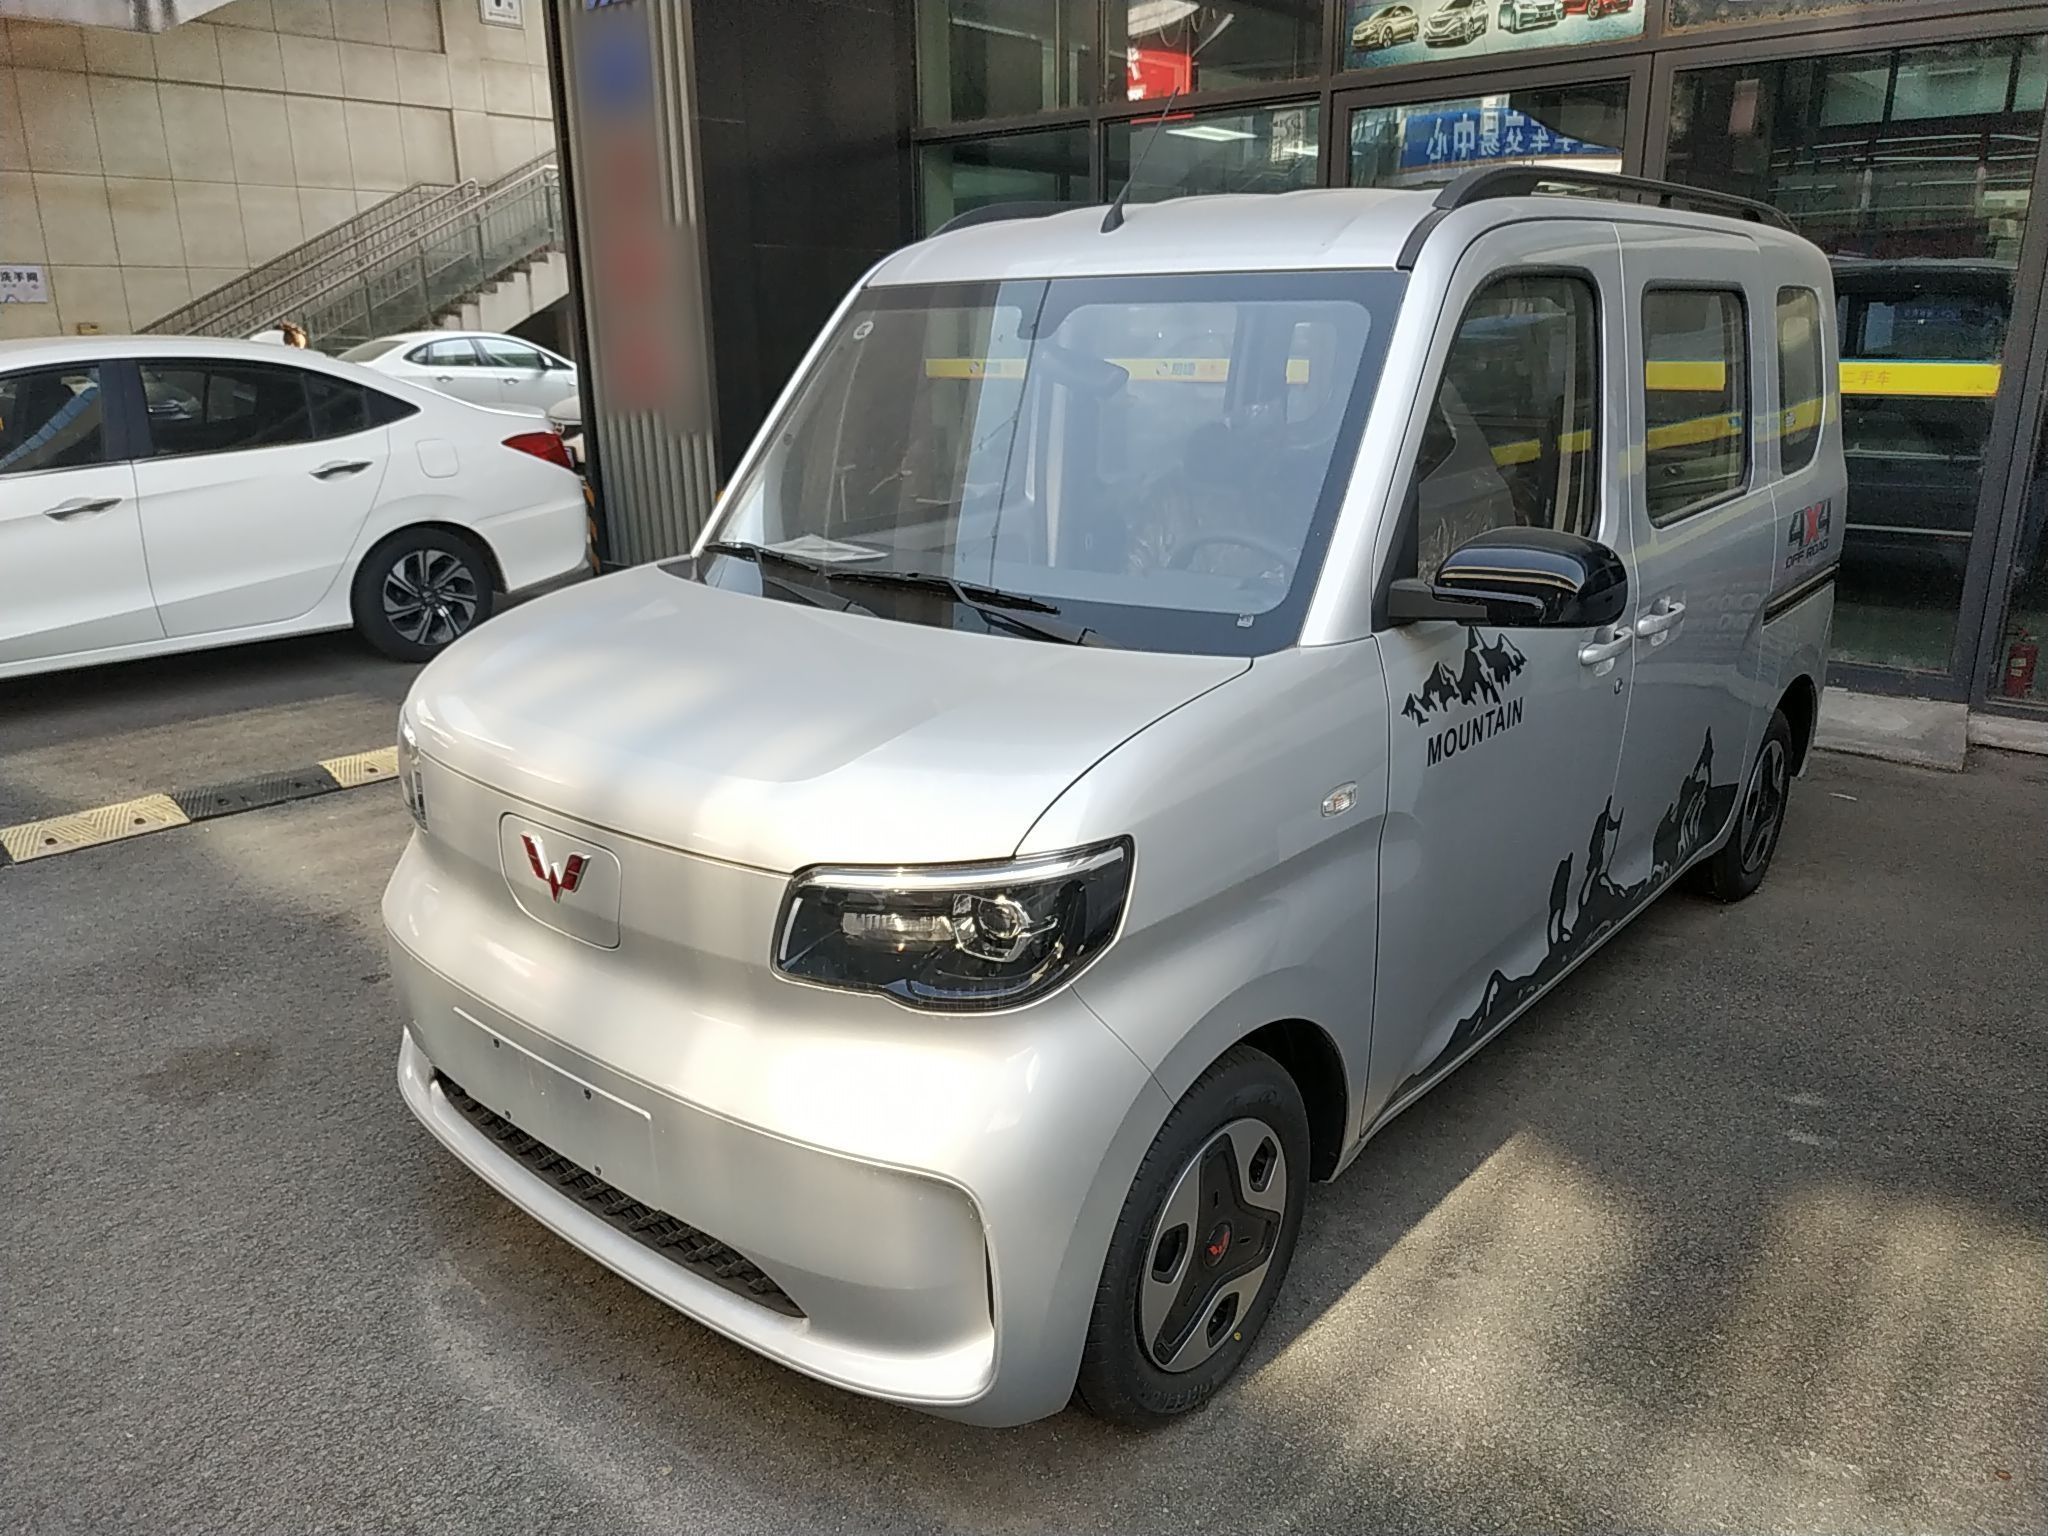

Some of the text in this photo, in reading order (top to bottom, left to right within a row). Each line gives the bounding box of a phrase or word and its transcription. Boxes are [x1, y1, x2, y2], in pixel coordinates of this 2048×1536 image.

[1785, 539, 1829, 569] OFF ROAD
[1427, 697, 1523, 768] MOUNTAIN
